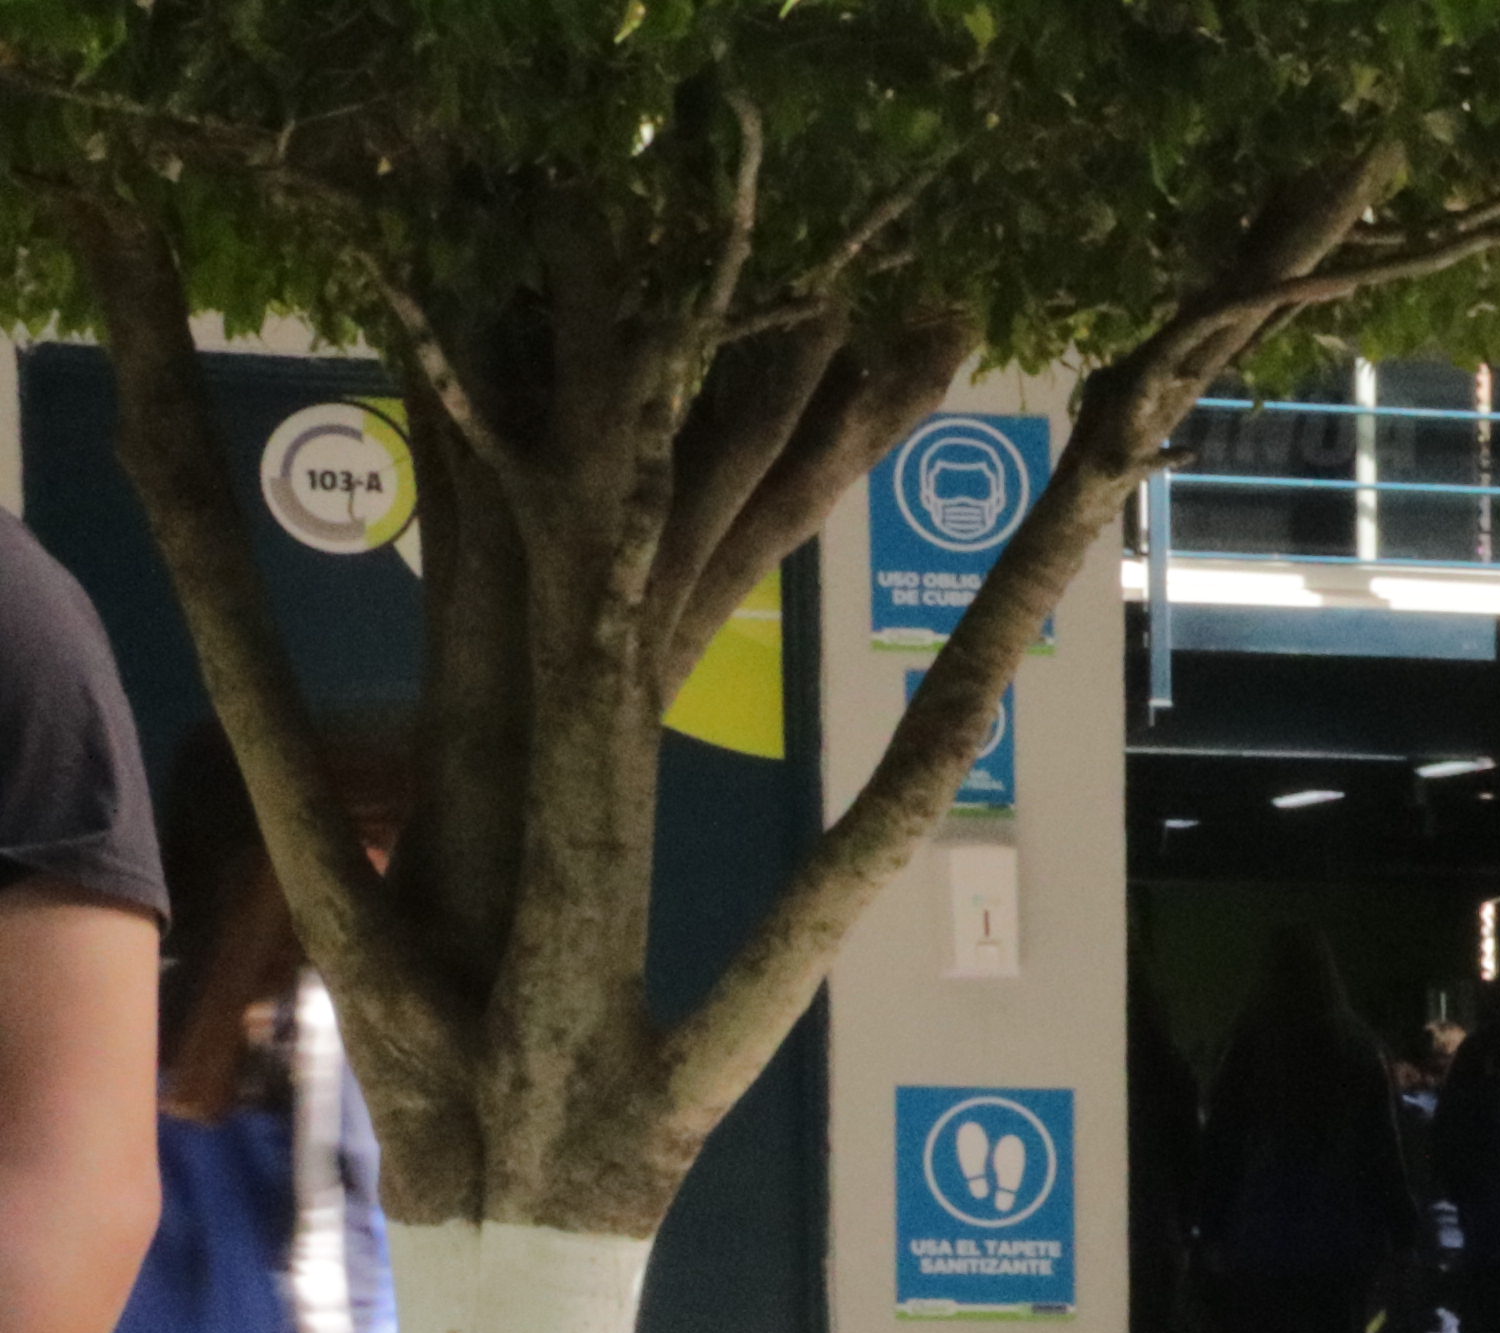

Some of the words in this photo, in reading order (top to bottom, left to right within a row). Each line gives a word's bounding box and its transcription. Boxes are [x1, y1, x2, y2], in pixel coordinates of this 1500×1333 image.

[306, 469, 384, 493] 103-A
[877, 571, 920, 588] USO
[922, 572, 982, 589] OBLIG
[892, 589, 920, 605] DE
[910, 1239, 953, 1256] USA
[955, 1239, 982, 1256] EL
[984, 1240, 1062, 1258] TAPETE
[920, 1257, 1055, 1275] SANITIZANTE
